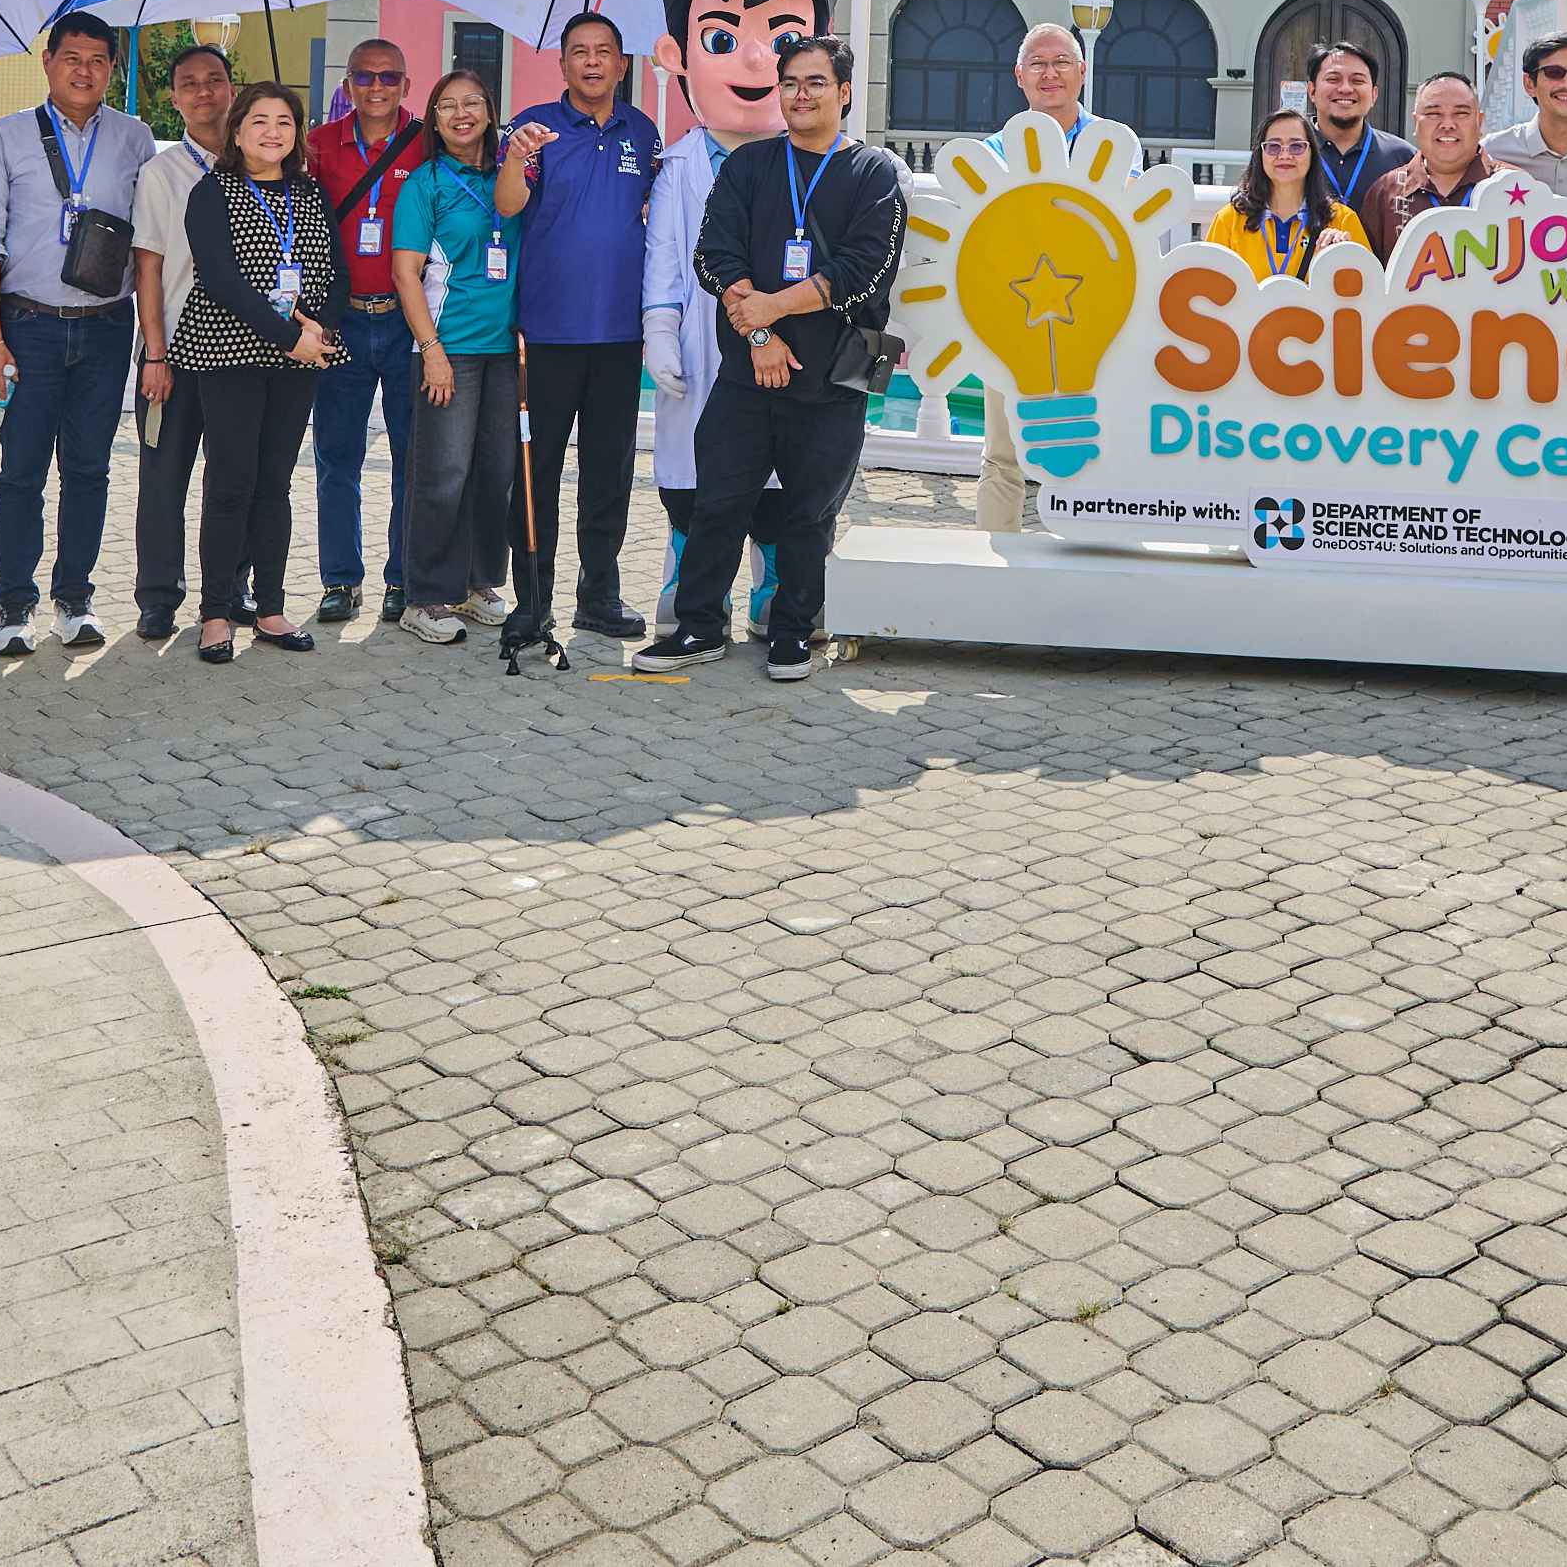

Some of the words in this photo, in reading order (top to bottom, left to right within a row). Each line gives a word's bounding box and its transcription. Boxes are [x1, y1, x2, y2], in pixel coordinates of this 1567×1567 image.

[1150, 403, 1479, 483] Discovery
[1050, 495, 1067, 511] In
[1073, 498, 1186, 521] partnership
[1193, 502, 1240, 521] with:
[1312, 502, 1448, 523] DEPARTMENT
[1452, 509, 1481, 524] OF
[1312, 520, 1398, 539] SCIENCE
[1403, 524, 1448, 541] AND
[1312, 538, 1396, 552] OneDOST4U:
[1399, 542, 1457, 555] Solutions
[1461, 544, 1484, 556] and
